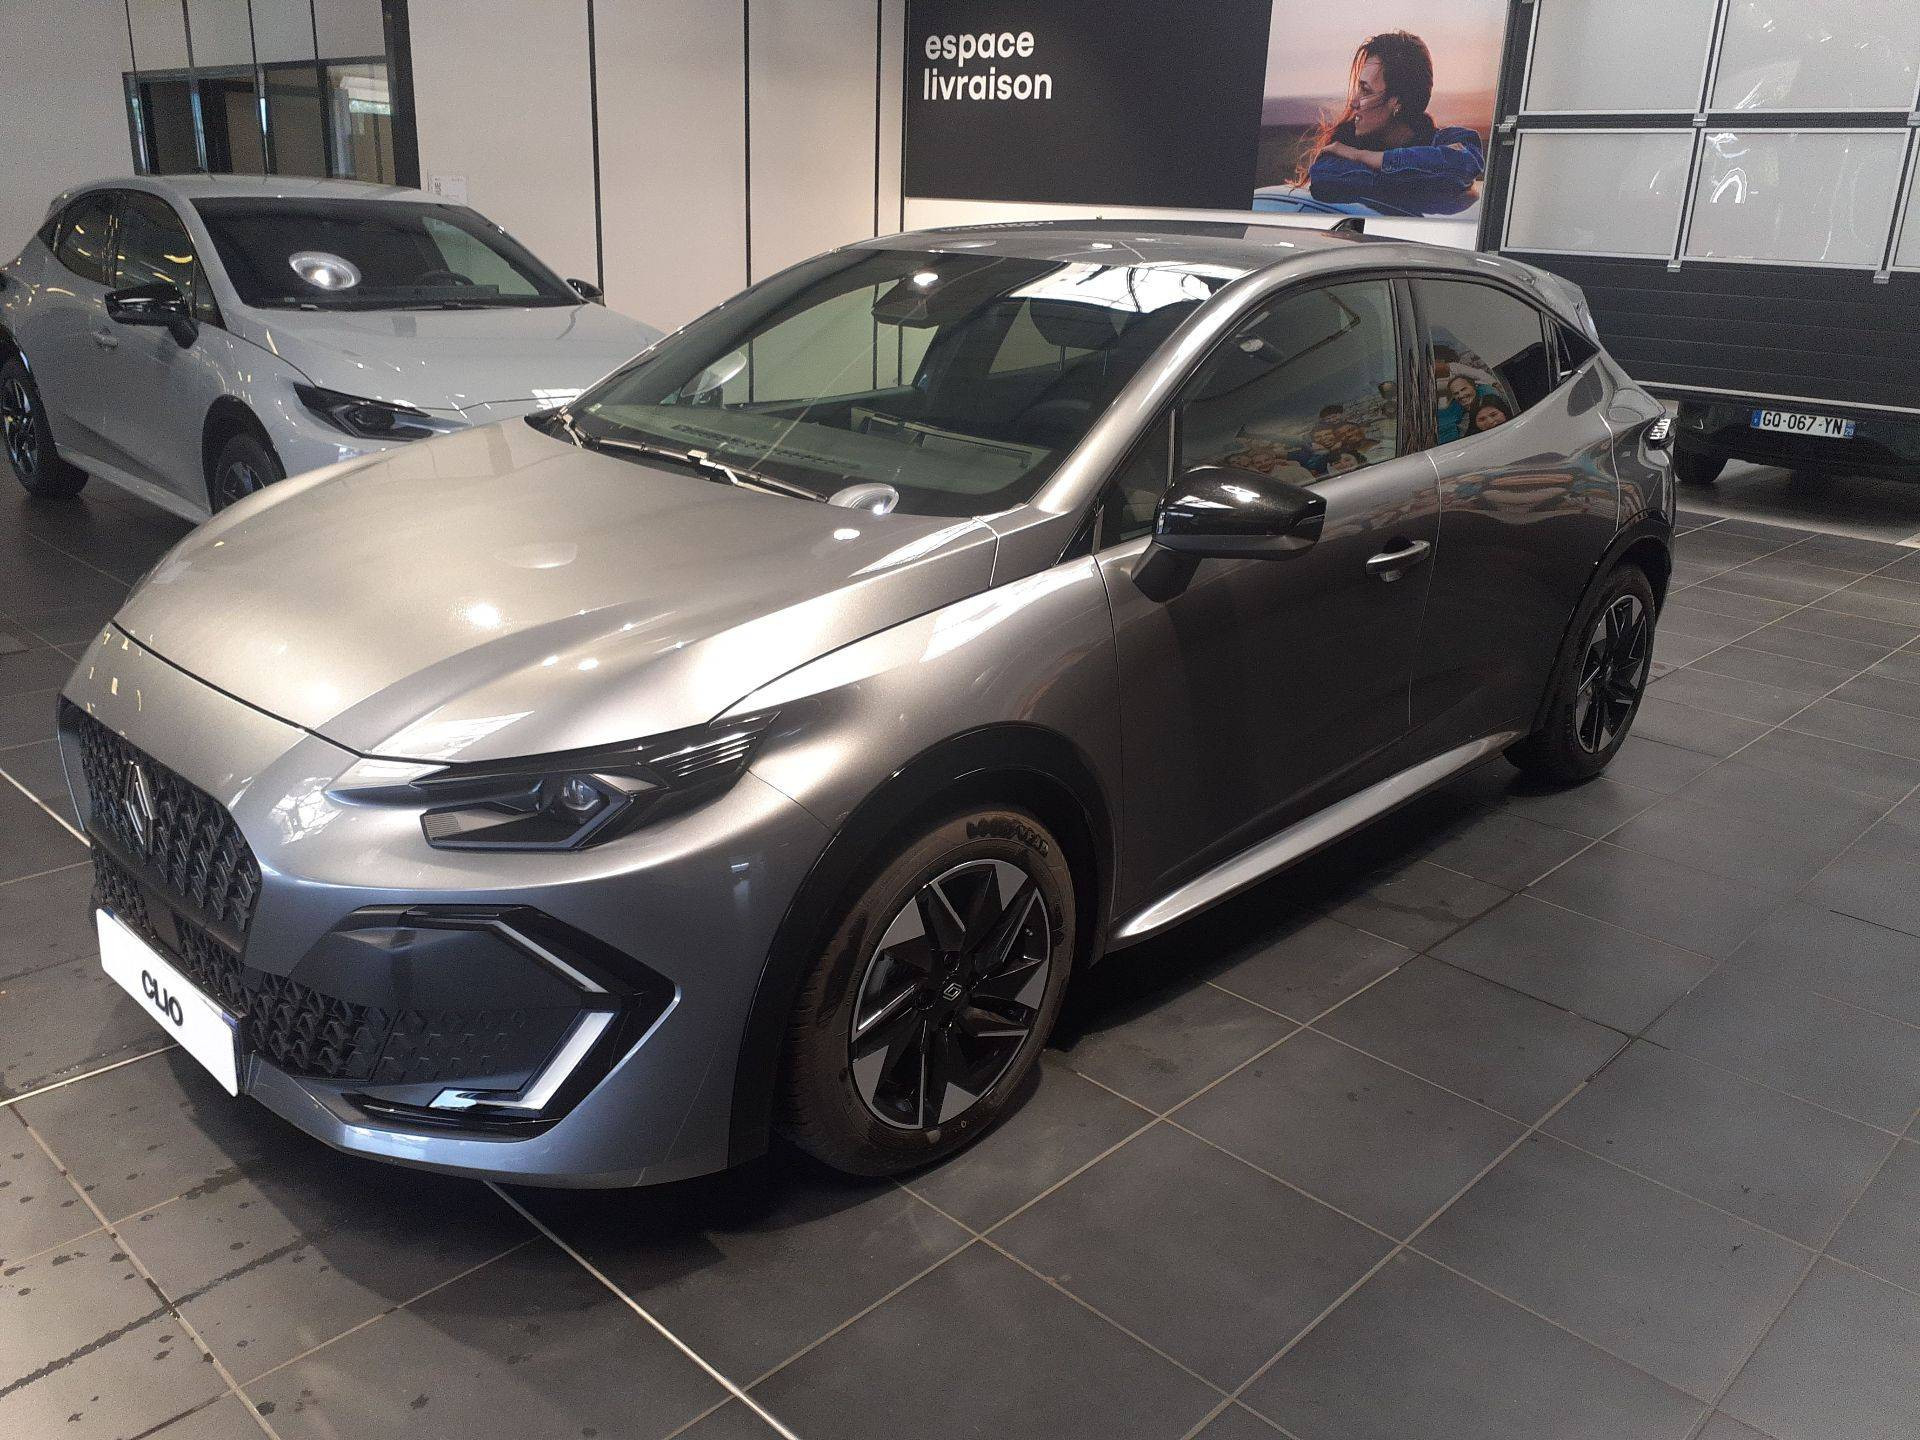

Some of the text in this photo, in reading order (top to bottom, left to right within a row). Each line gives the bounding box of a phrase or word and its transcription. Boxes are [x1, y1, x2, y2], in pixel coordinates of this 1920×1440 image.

[925, 31, 1035, 67] espace
[923, 66, 1053, 100] livraison
[1762, 411, 1844, 435] GQ-067-YN
[141, 969, 184, 1027] CLIO
